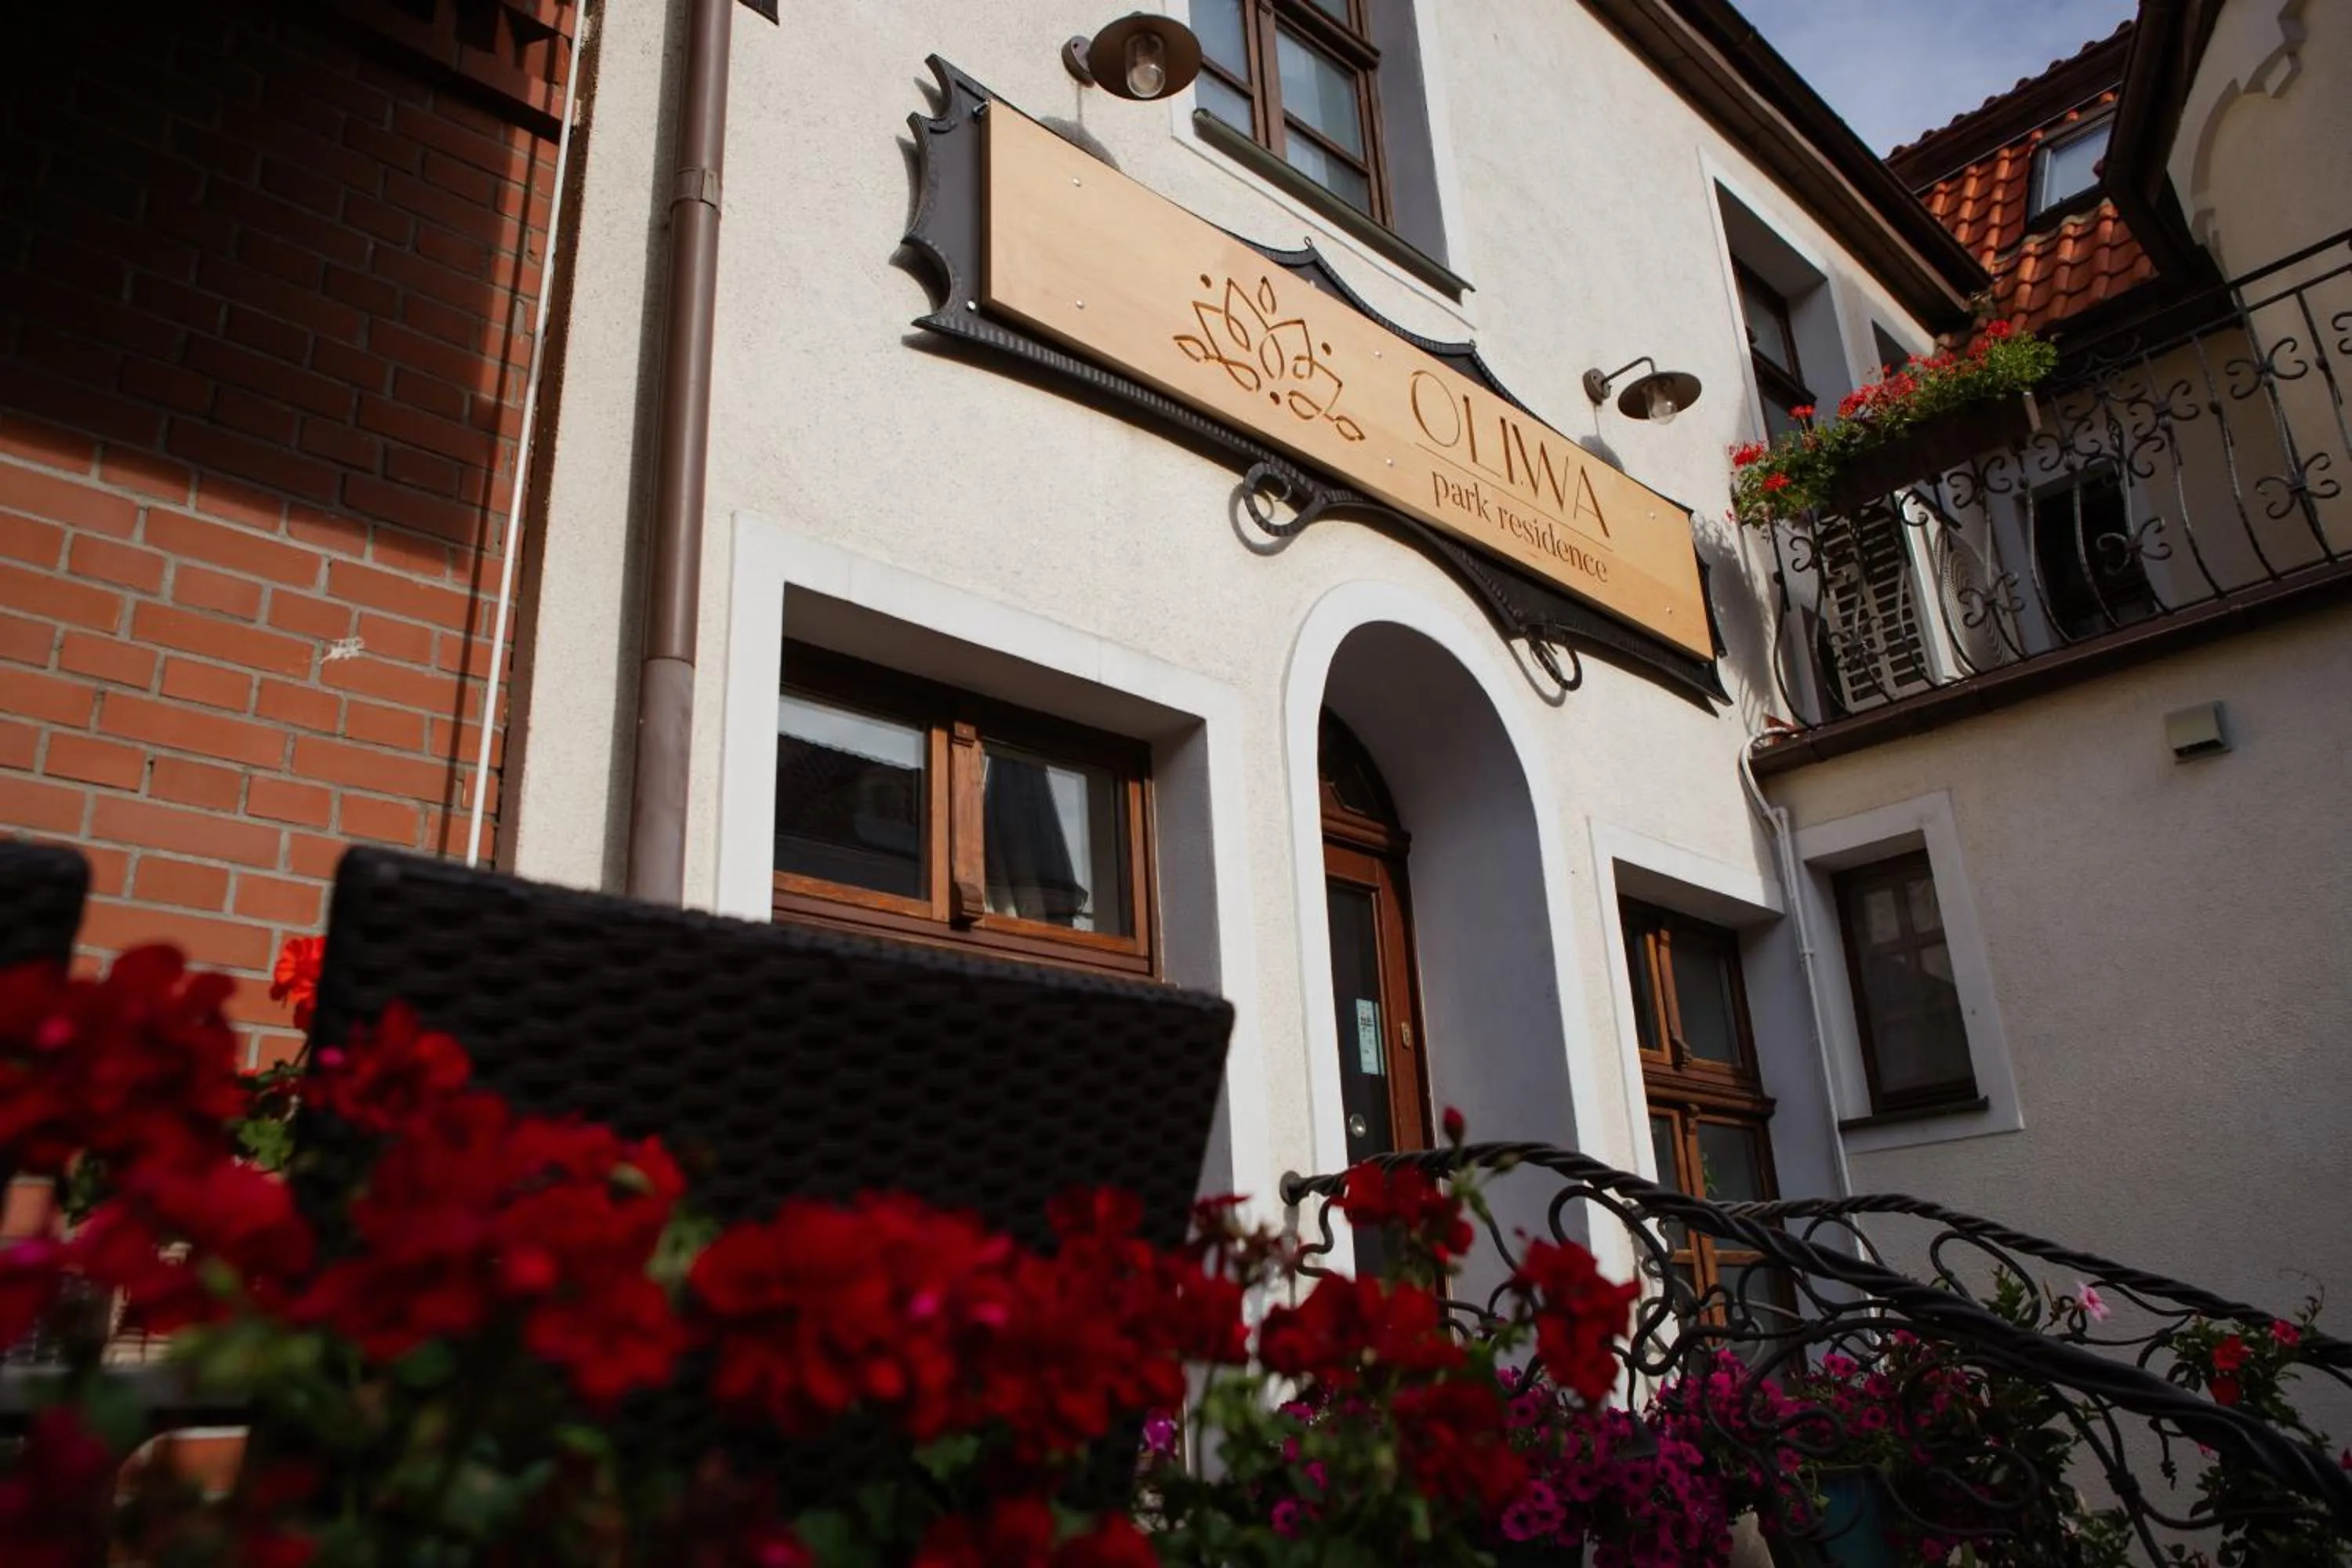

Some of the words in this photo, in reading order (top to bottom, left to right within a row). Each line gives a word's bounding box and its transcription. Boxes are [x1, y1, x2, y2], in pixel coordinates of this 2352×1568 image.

[1411, 369, 1610, 539] OLIWA
[1432, 471, 1491, 523] park
[1497, 504, 1608, 583] residence
